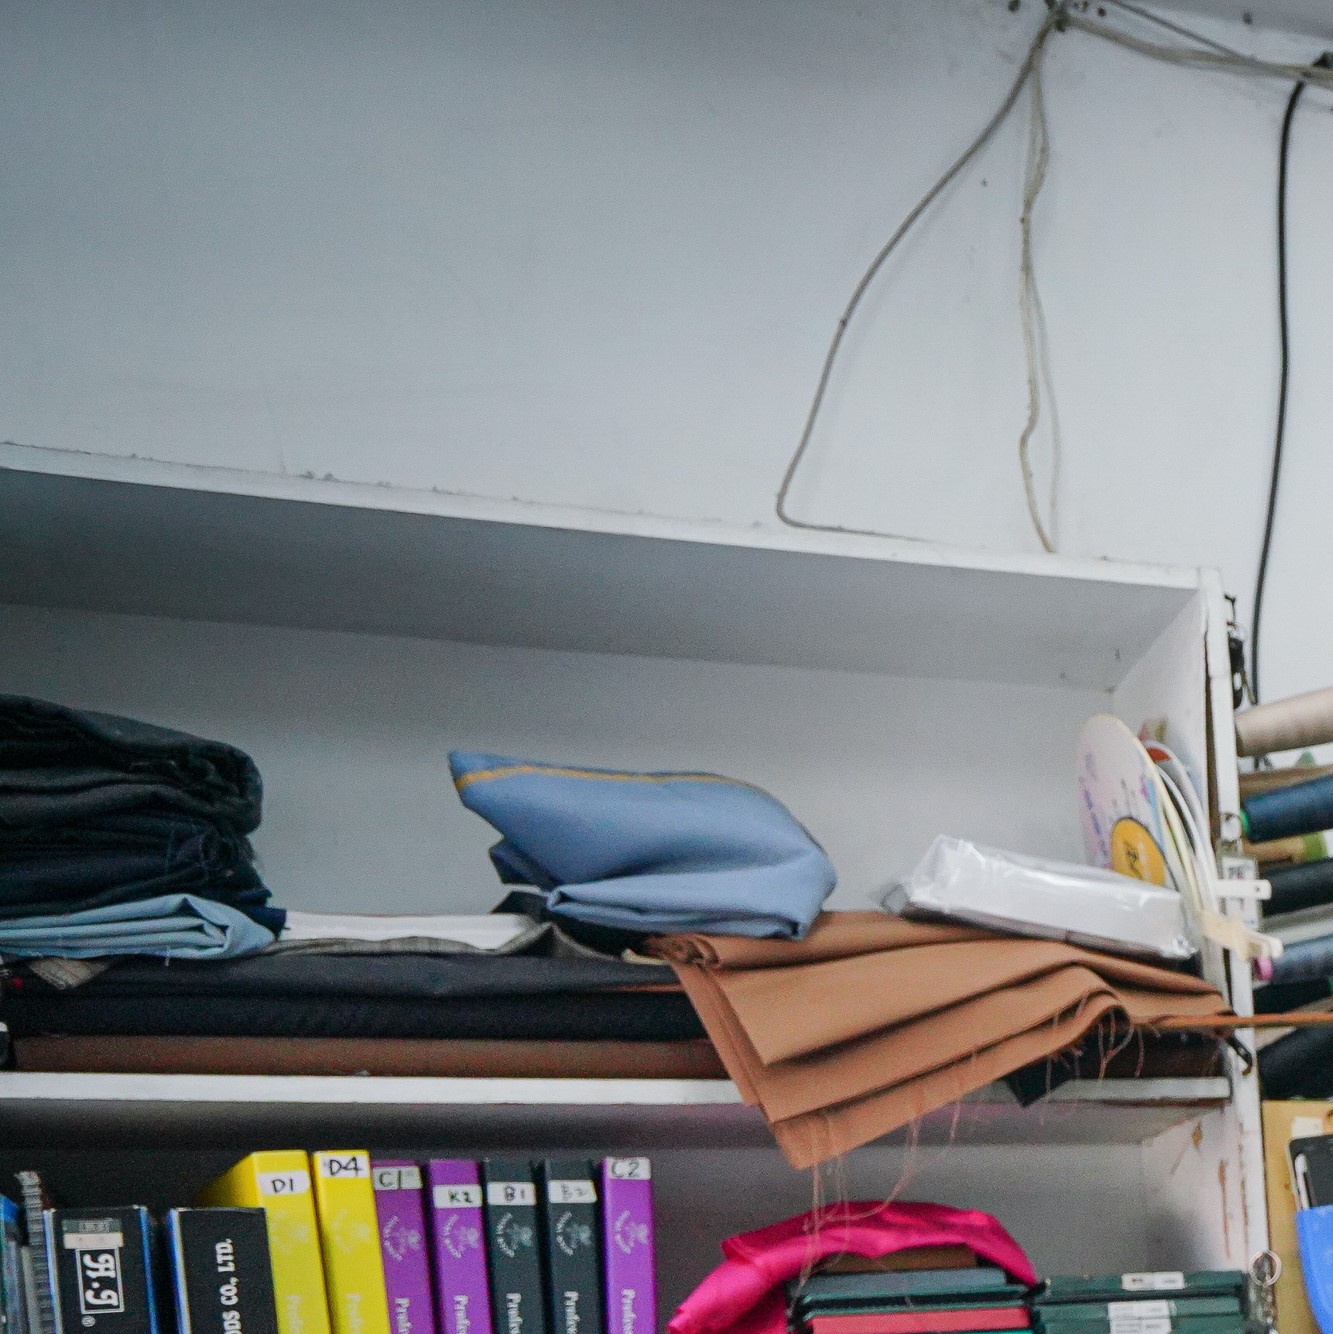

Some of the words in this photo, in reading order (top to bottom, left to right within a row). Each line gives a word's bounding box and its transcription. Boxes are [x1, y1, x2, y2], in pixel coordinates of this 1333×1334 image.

[328, 1156, 361, 1176] D4
[612, 1161, 640, 1178] C2
[271, 1178, 294, 1193] D1
[504, 1184, 526, 1203] B1
[215, 1238, 235, 1273] LTD.
[220, 1276, 239, 1306] CO.,
